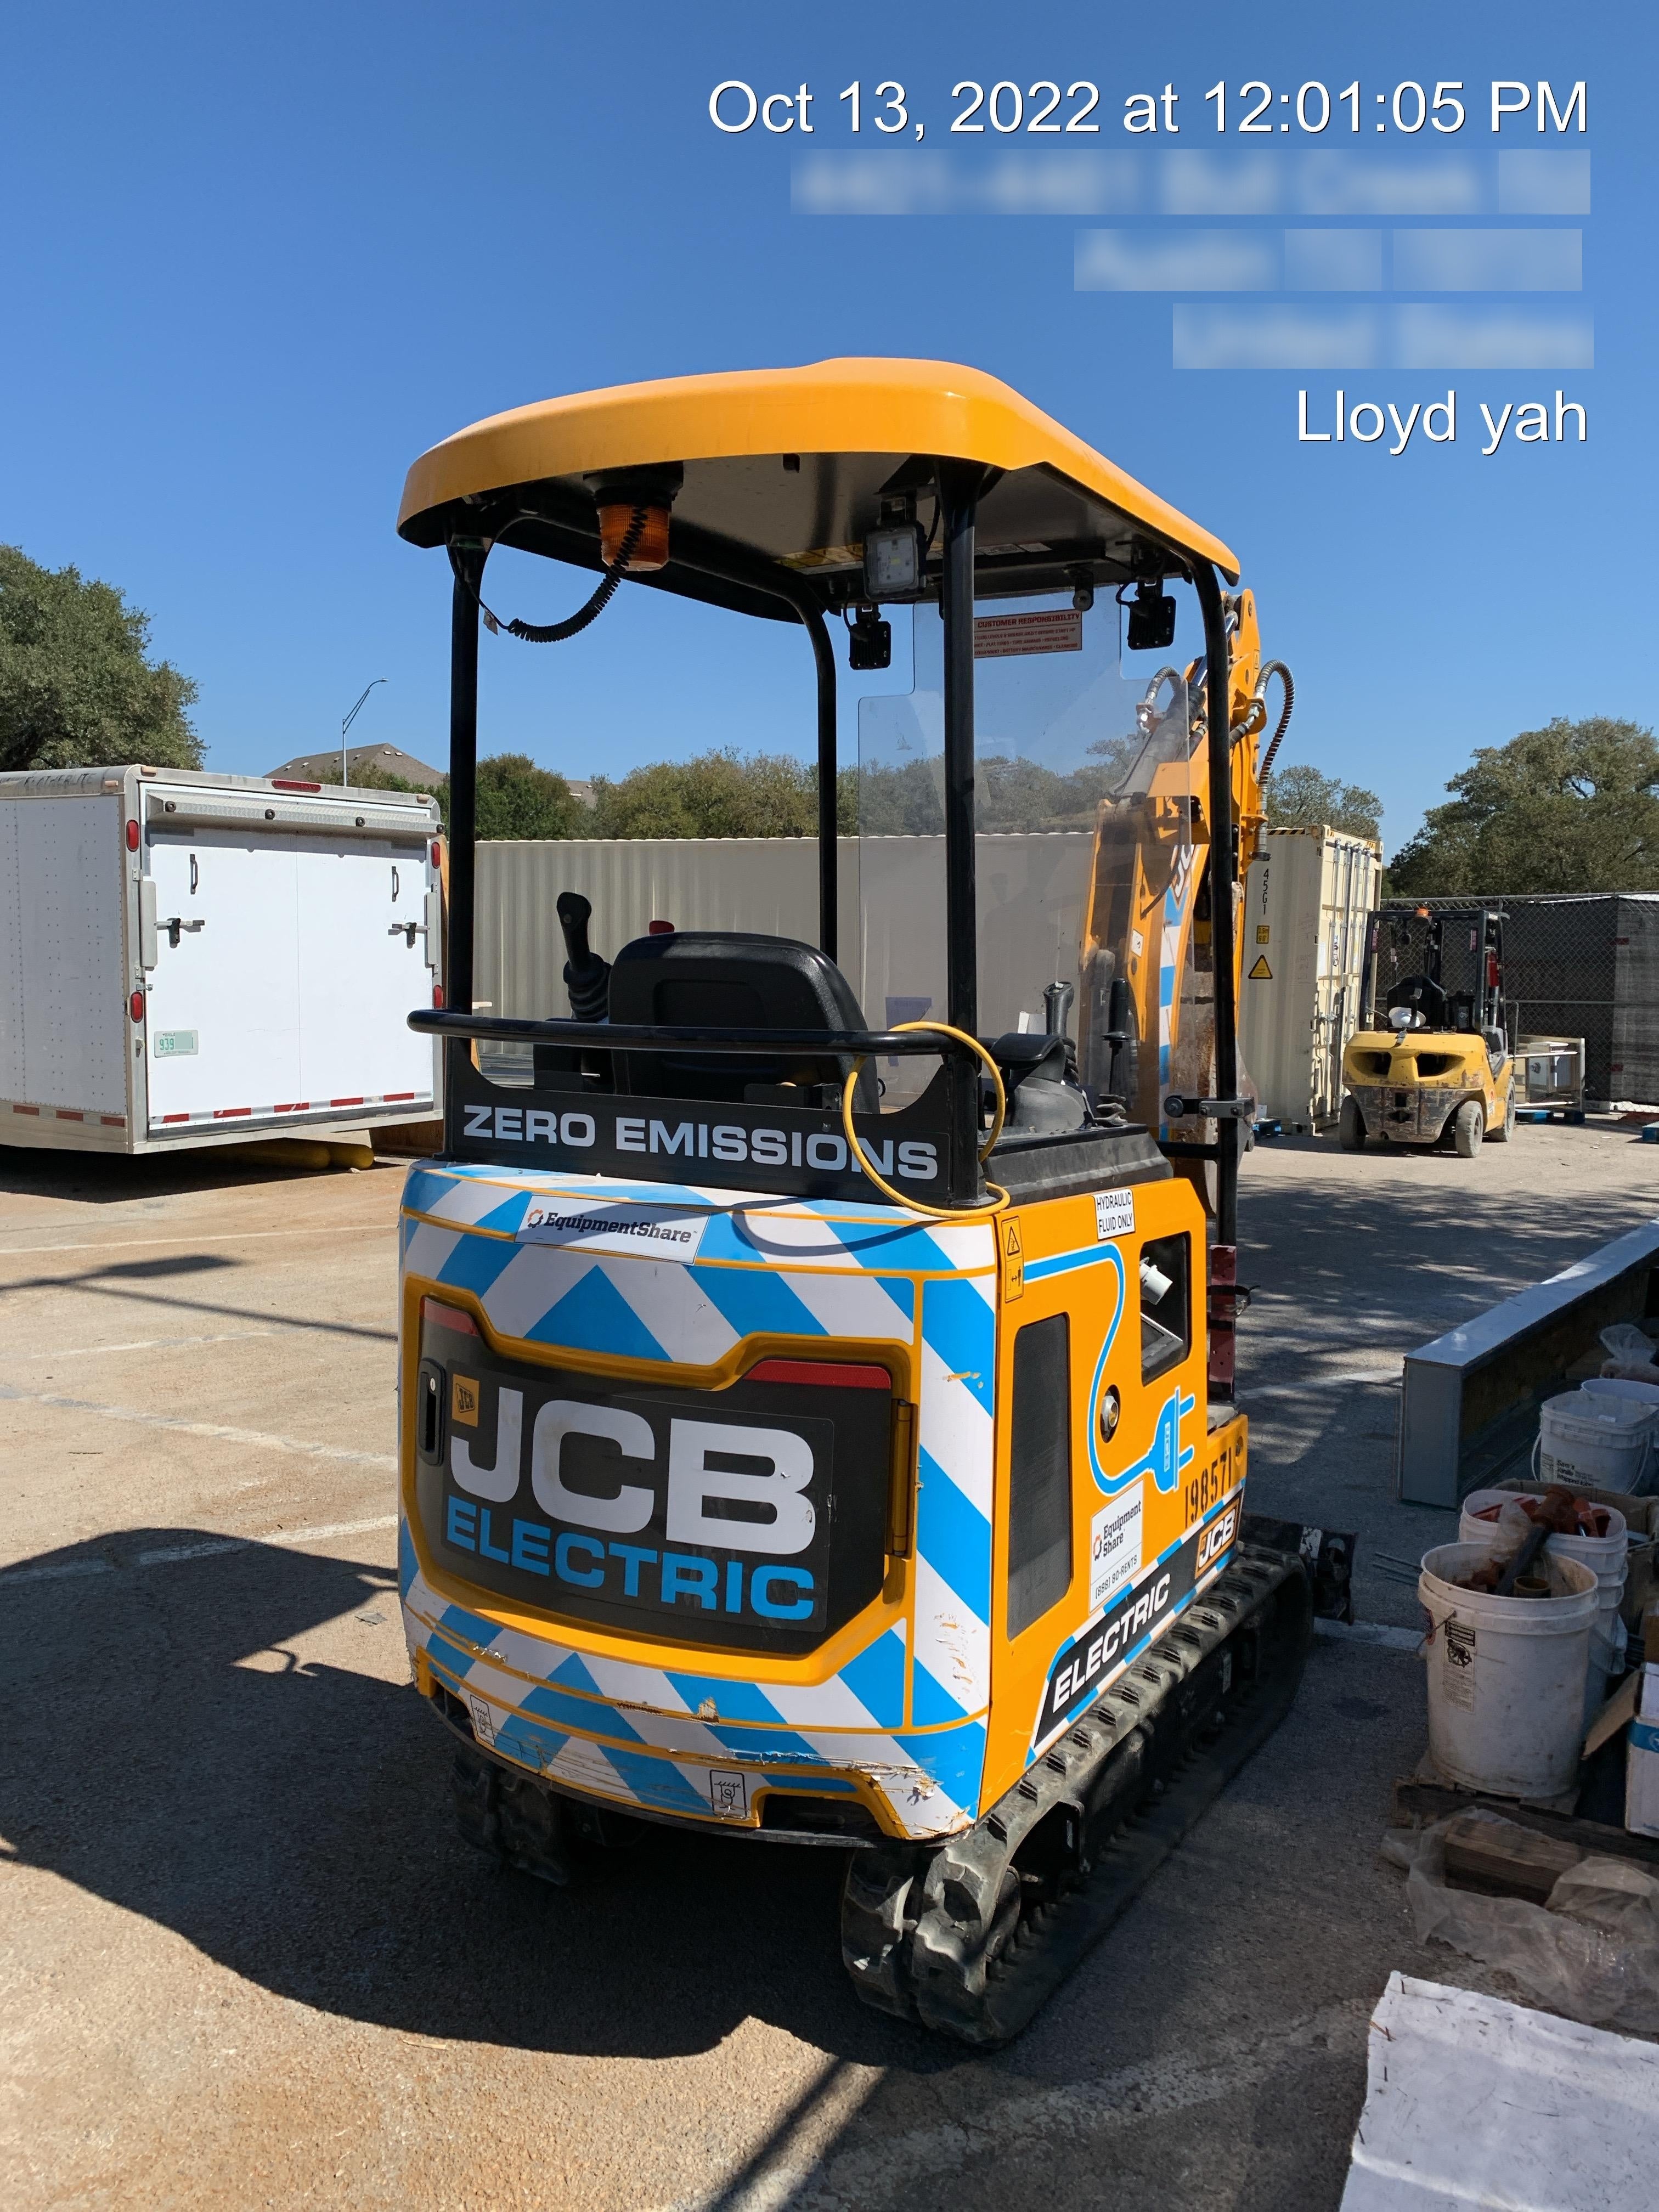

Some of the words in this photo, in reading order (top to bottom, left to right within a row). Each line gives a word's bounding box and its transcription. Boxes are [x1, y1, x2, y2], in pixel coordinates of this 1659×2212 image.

[978, 618, 1017, 628] CUSTOMER
[1018, 613, 1080, 625] RESPONSIBILITY
[463, 1104, 596, 1148] ZERO
[616, 1116, 938, 1180] EMISSIONS
[1096, 1192, 1132, 1211] HYDRAULIC
[1098, 1216, 1116, 1233] FLUID
[1118, 1212, 1132, 1229] ONLY
[544, 1211, 692, 1244] EquipmentShare
[450, 1386, 817, 1556] JCB
[1185, 1446, 1232, 1530] 198571
[1103, 1500, 1142, 1541] Equipment
[1198, 1508, 1235, 1568] JCB
[446, 1494, 815, 1621] ELECTRIC
[1103, 1532, 1124, 1558] Share
[1095, 1577, 1111, 1600] (888)
[1111, 1554, 1138, 1584] 80-RENTS
[1052, 1573, 1171, 1714] ELECTRIC
